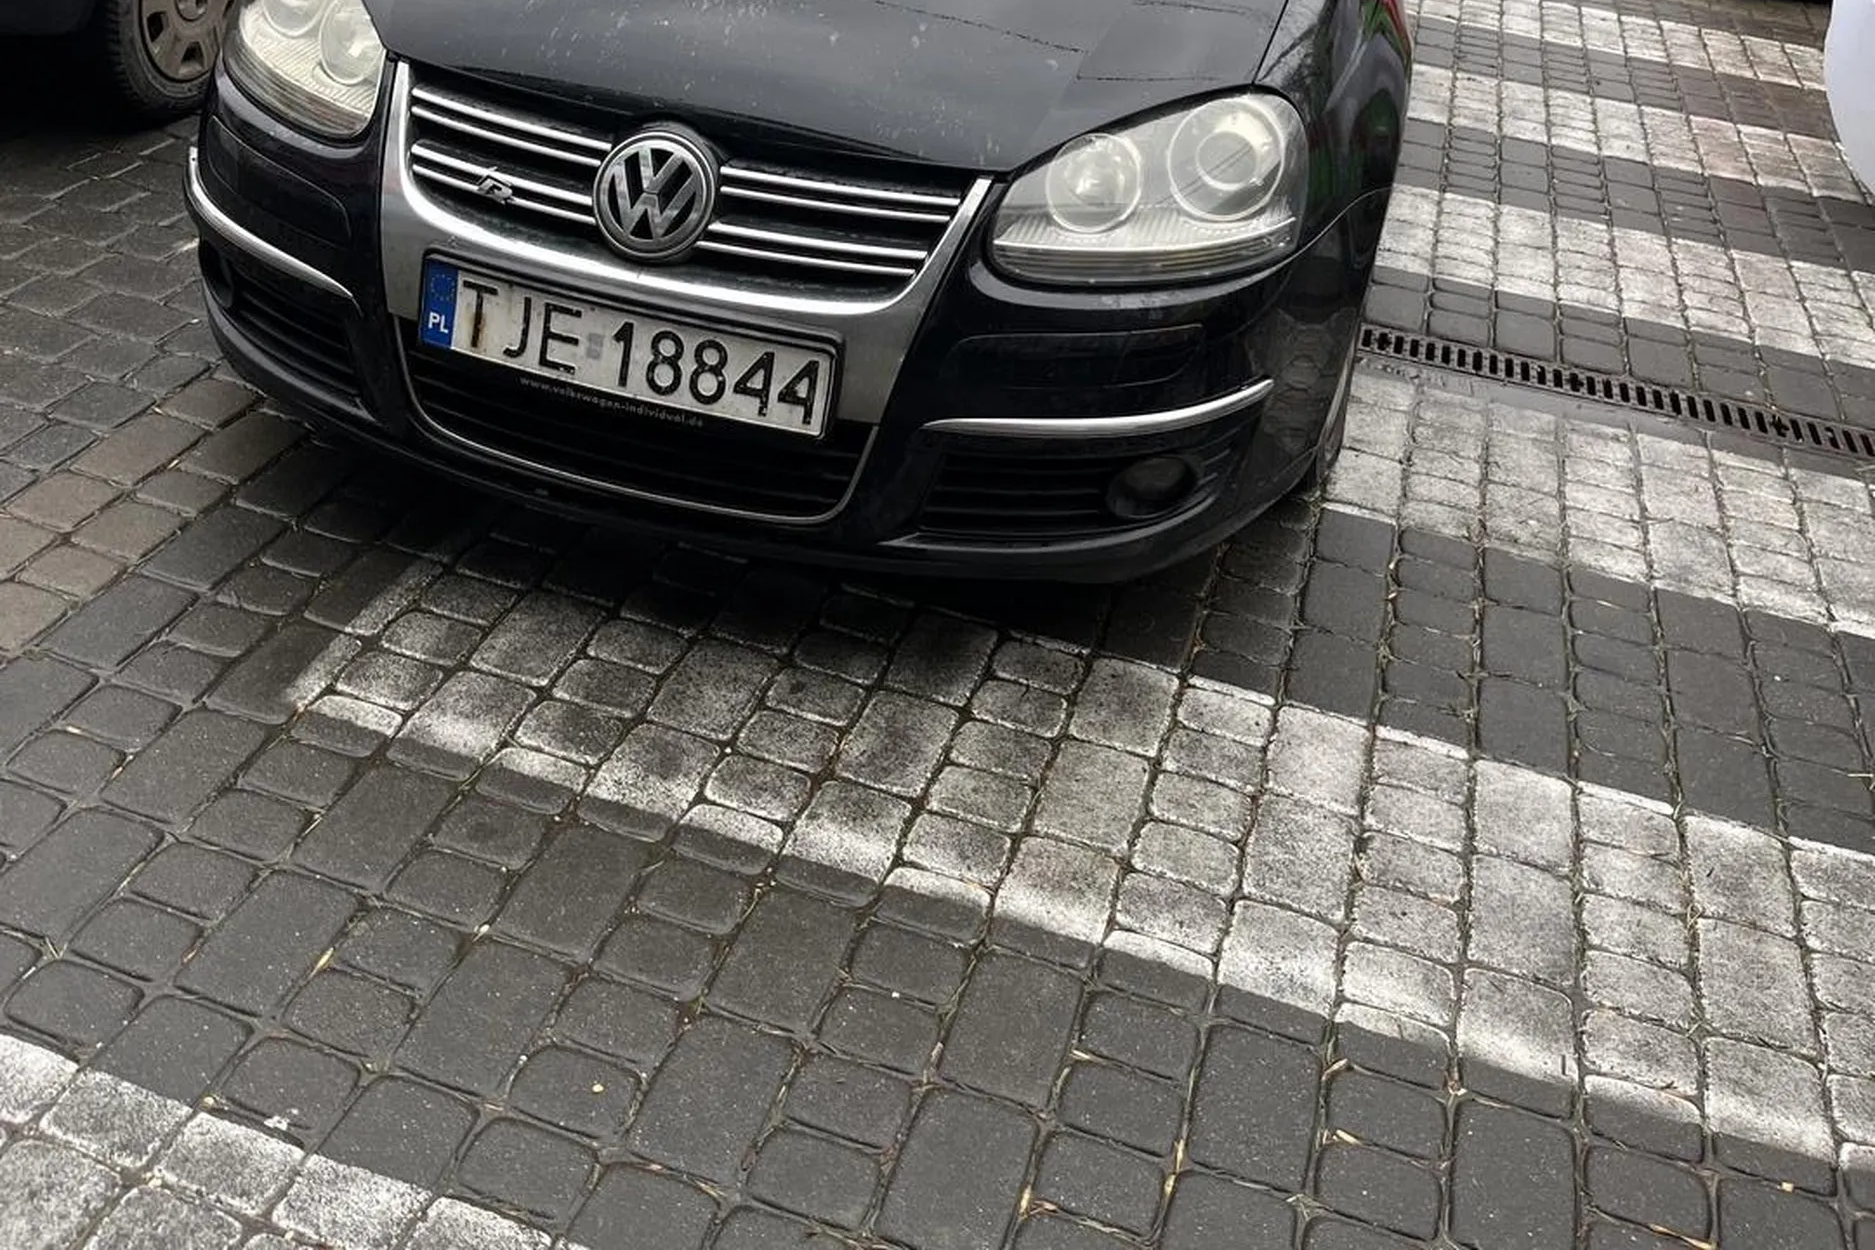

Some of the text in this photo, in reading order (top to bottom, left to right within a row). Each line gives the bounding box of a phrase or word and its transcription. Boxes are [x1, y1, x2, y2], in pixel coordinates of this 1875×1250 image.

[428, 311, 449, 333] PL
[463, 279, 819, 425] TJE 18844
